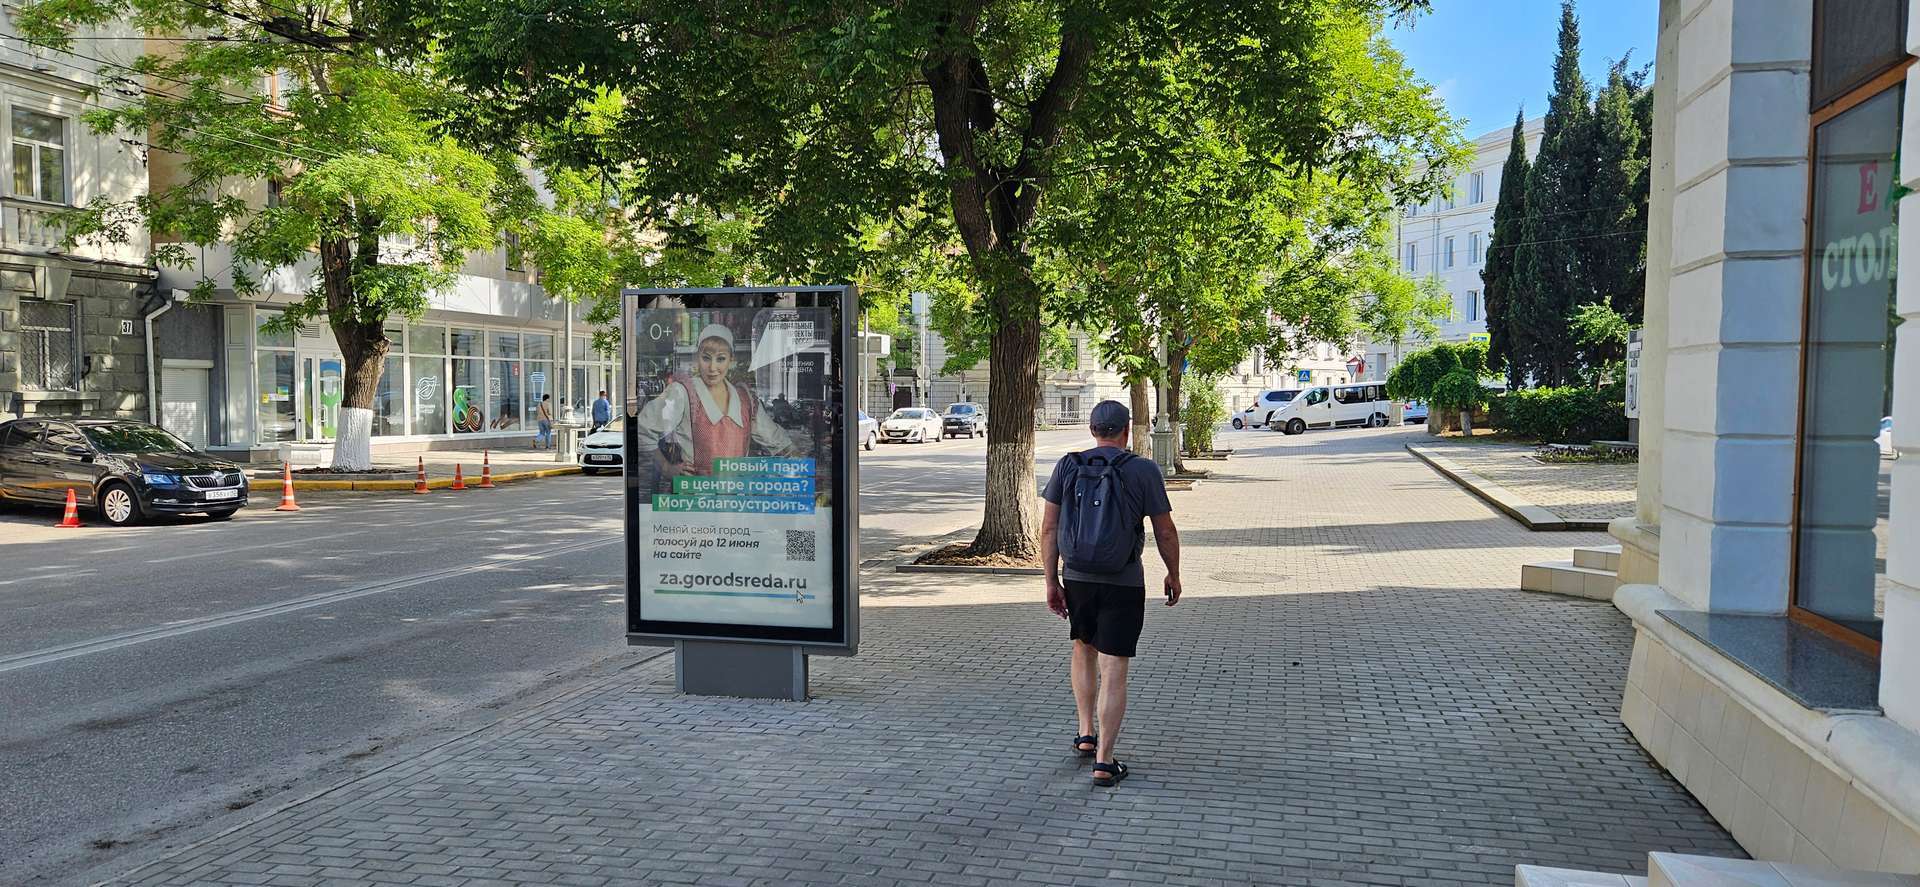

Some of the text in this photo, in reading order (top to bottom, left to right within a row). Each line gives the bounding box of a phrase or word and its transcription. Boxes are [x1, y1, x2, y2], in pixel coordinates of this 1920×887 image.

[122, 321, 132, 333] 37
[650, 323, 672, 340] 0+
[720, 458, 809, 475] Новый парк
[681, 480, 809, 494] в центре города?
[658, 497, 809, 512] Могу благоустроить.
[653, 524, 689, 534] Меняй
[691, 525, 715, 534] свой
[719, 527, 750, 536] город
[653, 537, 760, 549] голосуй до 12 июня
[653, 550, 702, 559] на сайте
[659, 572, 807, 589] za.gorodsreda.ru
